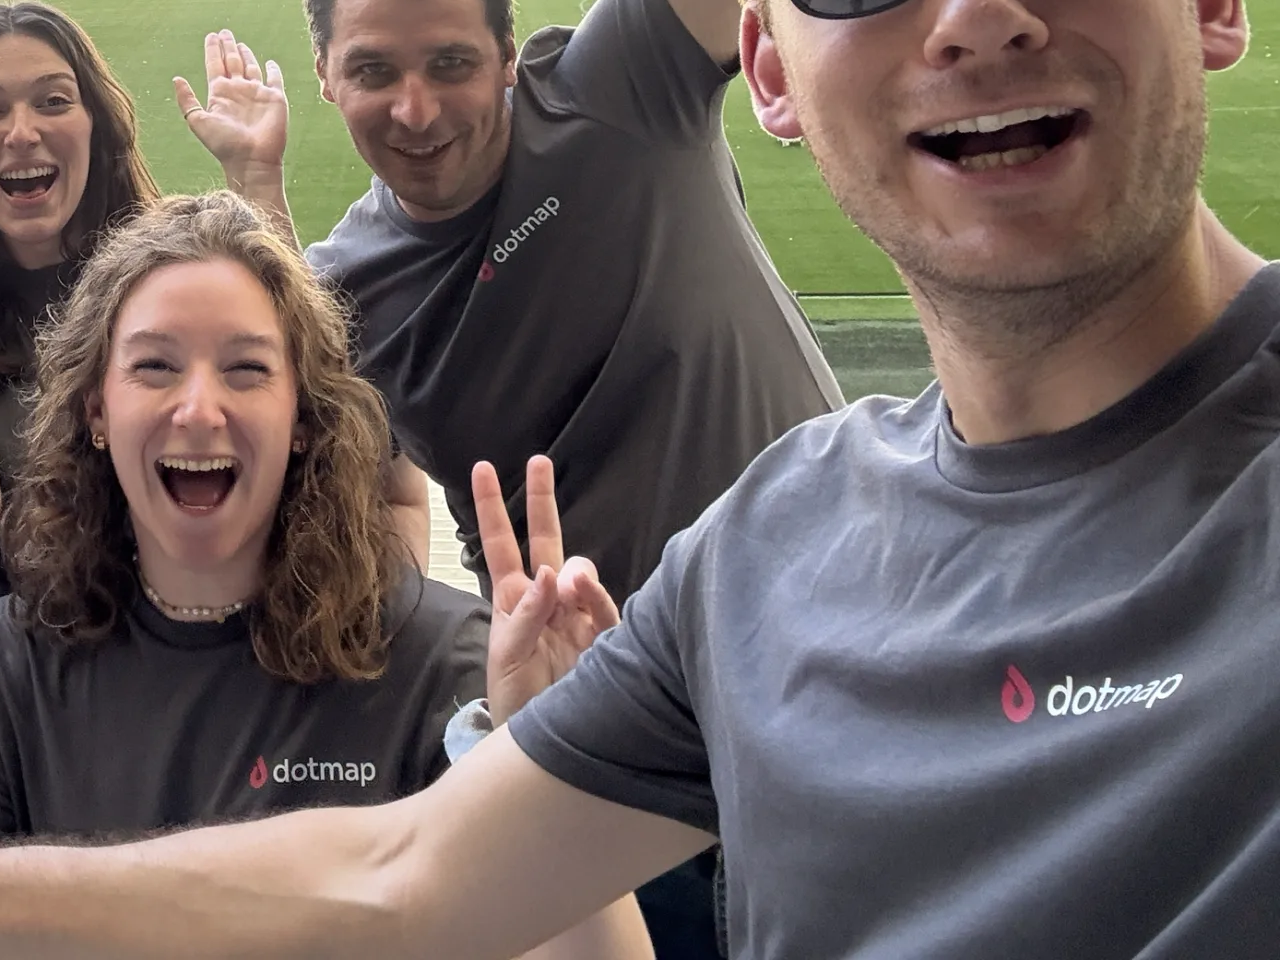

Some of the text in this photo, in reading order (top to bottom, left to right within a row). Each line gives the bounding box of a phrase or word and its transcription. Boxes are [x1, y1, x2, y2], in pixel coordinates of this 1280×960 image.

[493, 196, 560, 263] dotmap
[1047, 673, 1184, 717] dotmap
[273, 757, 376, 787] dotmap
